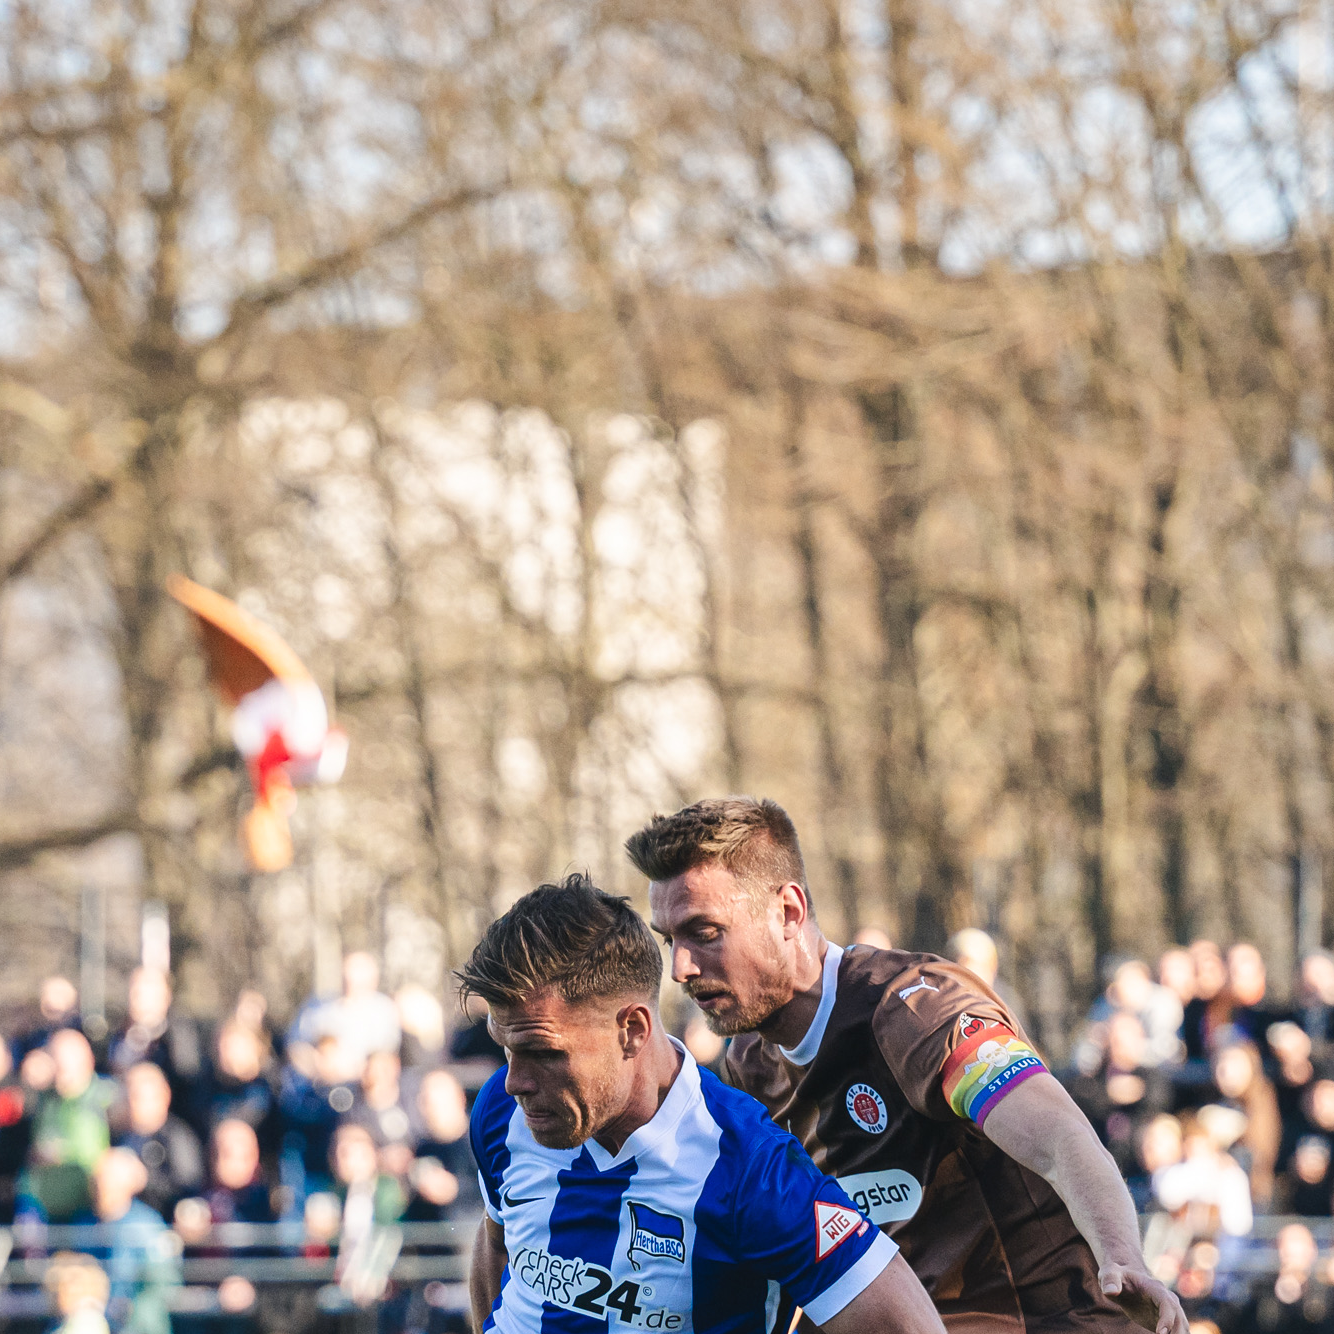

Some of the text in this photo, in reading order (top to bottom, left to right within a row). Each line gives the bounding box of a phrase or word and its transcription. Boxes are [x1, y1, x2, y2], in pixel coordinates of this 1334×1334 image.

[822, 1211, 851, 1241] WTG
[635, 1231, 683, 1257] Hertha BSC
[527, 1249, 586, 1286] check
[520, 1265, 575, 1304] CARS
